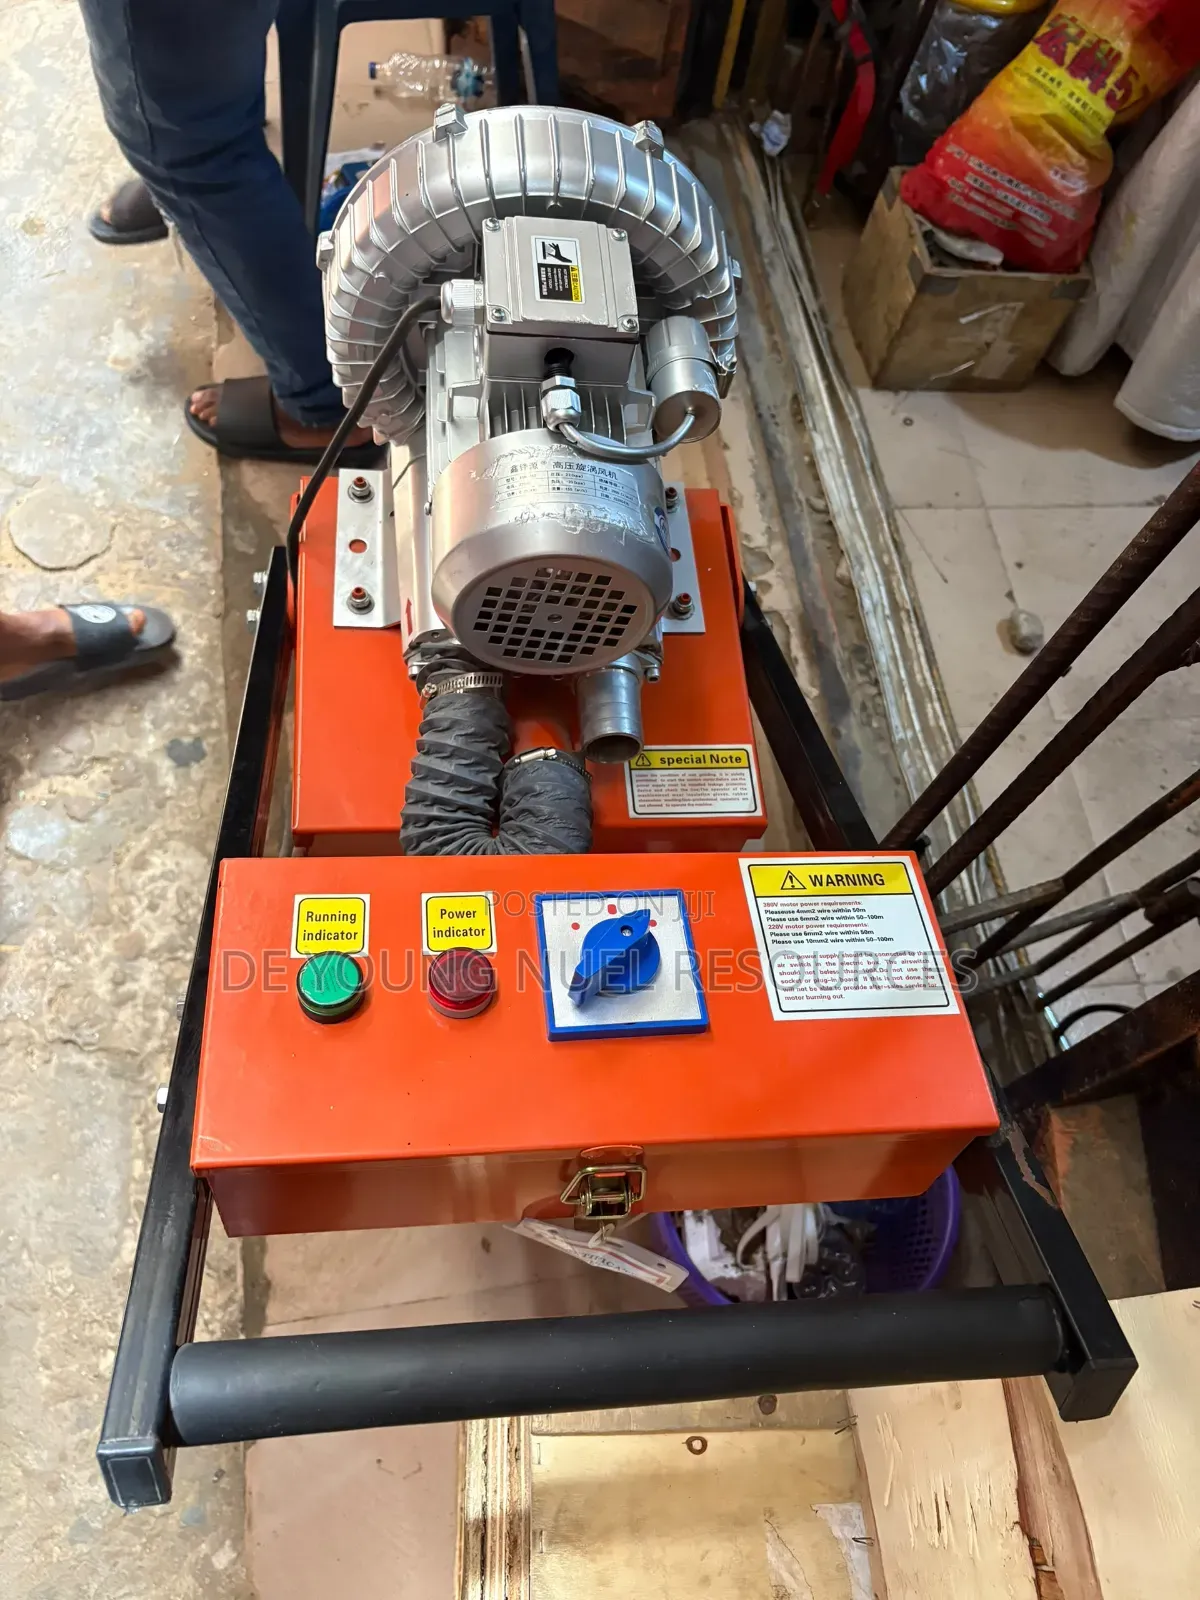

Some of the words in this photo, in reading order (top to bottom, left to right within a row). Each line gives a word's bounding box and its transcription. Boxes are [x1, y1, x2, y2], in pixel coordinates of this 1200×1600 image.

[552, 461, 618, 480] 高压旋涡风机
[659, 754, 706, 766] special
[709, 753, 742, 764] Note
[808, 873, 885, 887] WARNING
[306, 910, 357, 924] Running
[440, 908, 477, 919] Power
[303, 929, 358, 941] indicator
[432, 926, 486, 938] indicator
